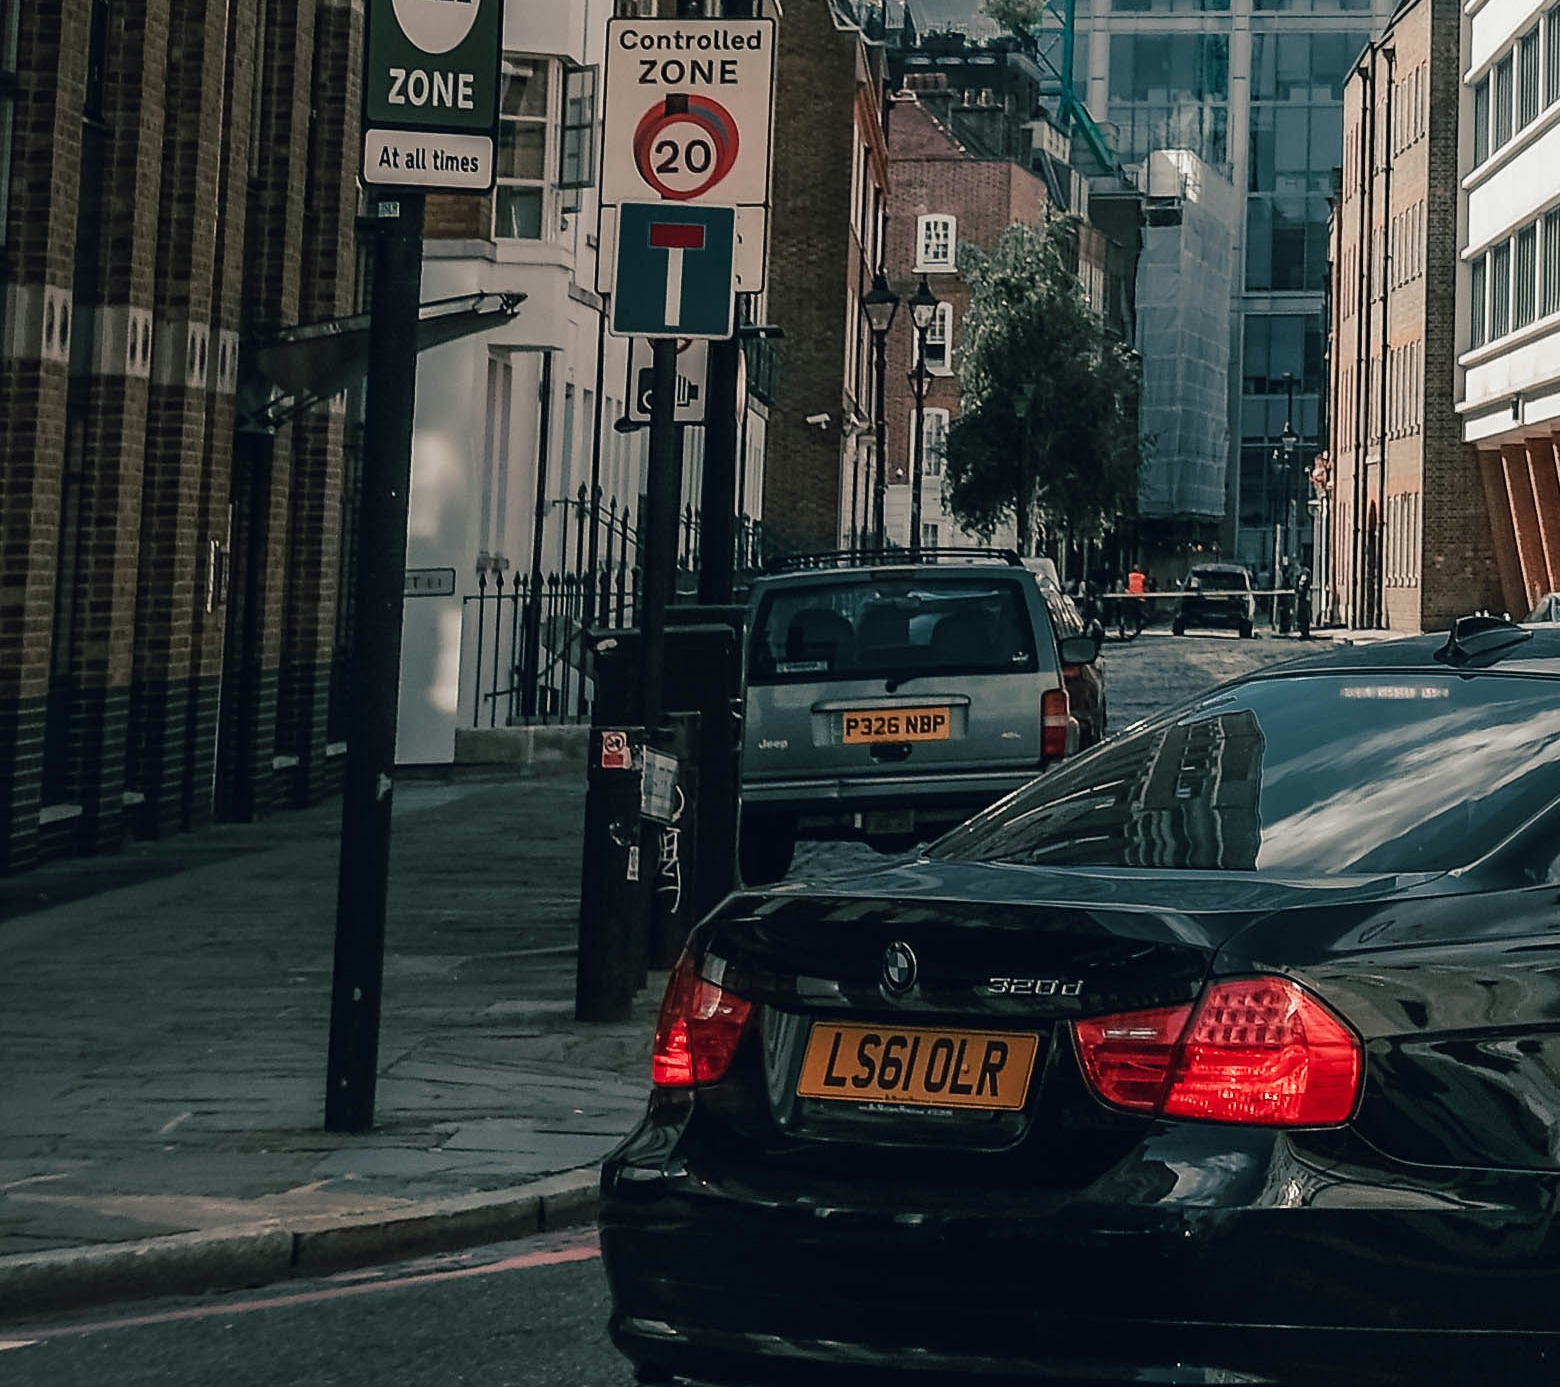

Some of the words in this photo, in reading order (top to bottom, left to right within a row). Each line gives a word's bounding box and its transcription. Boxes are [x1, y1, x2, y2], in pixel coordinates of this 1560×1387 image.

[618, 29, 763, 52] Controlled
[637, 59, 739, 86] ZONE
[388, 68, 475, 110] ZONE
[378, 145, 400, 170] At
[405, 147, 426, 170] all
[432, 148, 480, 173] times
[654, 137, 712, 175] 20
[845, 716, 900, 737] P326
[905, 714, 945, 735] NBP
[758, 738, 789, 750] Jeep
[987, 977, 1084, 996] 320d
[823, 1032, 921, 1092] LS61
[923, 1037, 1009, 1097] OLR
